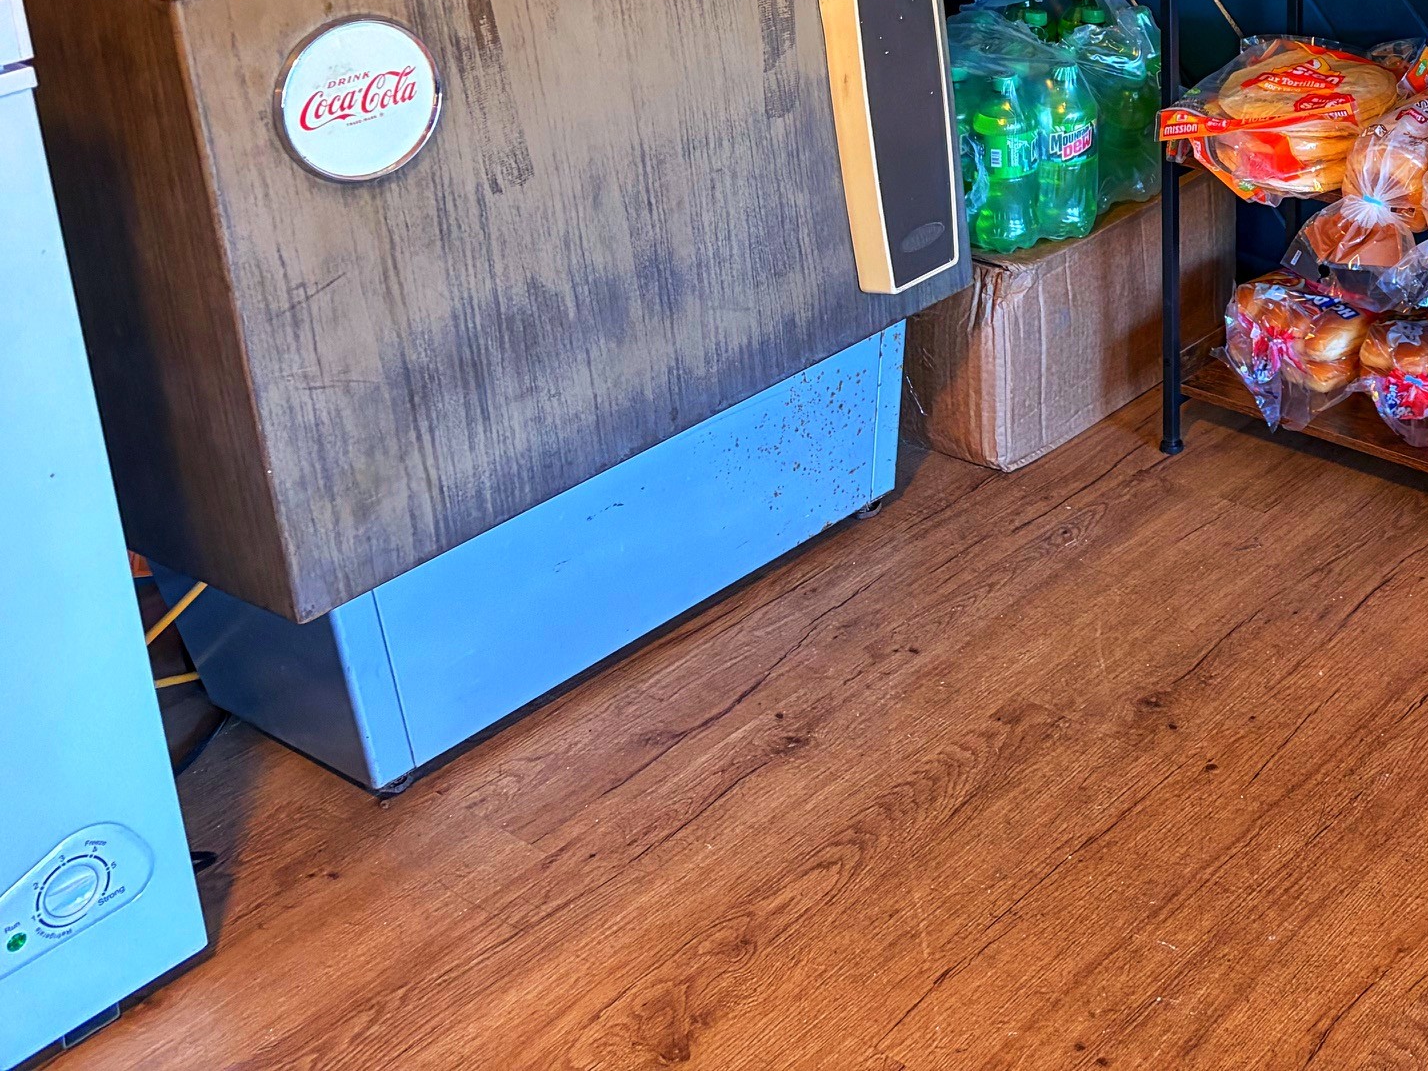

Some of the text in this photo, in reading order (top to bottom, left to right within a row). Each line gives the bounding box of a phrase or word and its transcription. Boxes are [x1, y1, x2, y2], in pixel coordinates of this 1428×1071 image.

[327, 71, 370, 89] DRINK
[1281, 77, 1326, 88] Tortillas
[300, 65, 417, 131] Coca-Cola
[84, 839, 107, 847] Freeze
[58, 855, 65, 863] 3
[111, 861, 117, 870] 5
[33, 882, 39, 890] 2
[98, 886, 126, 906] Strong
